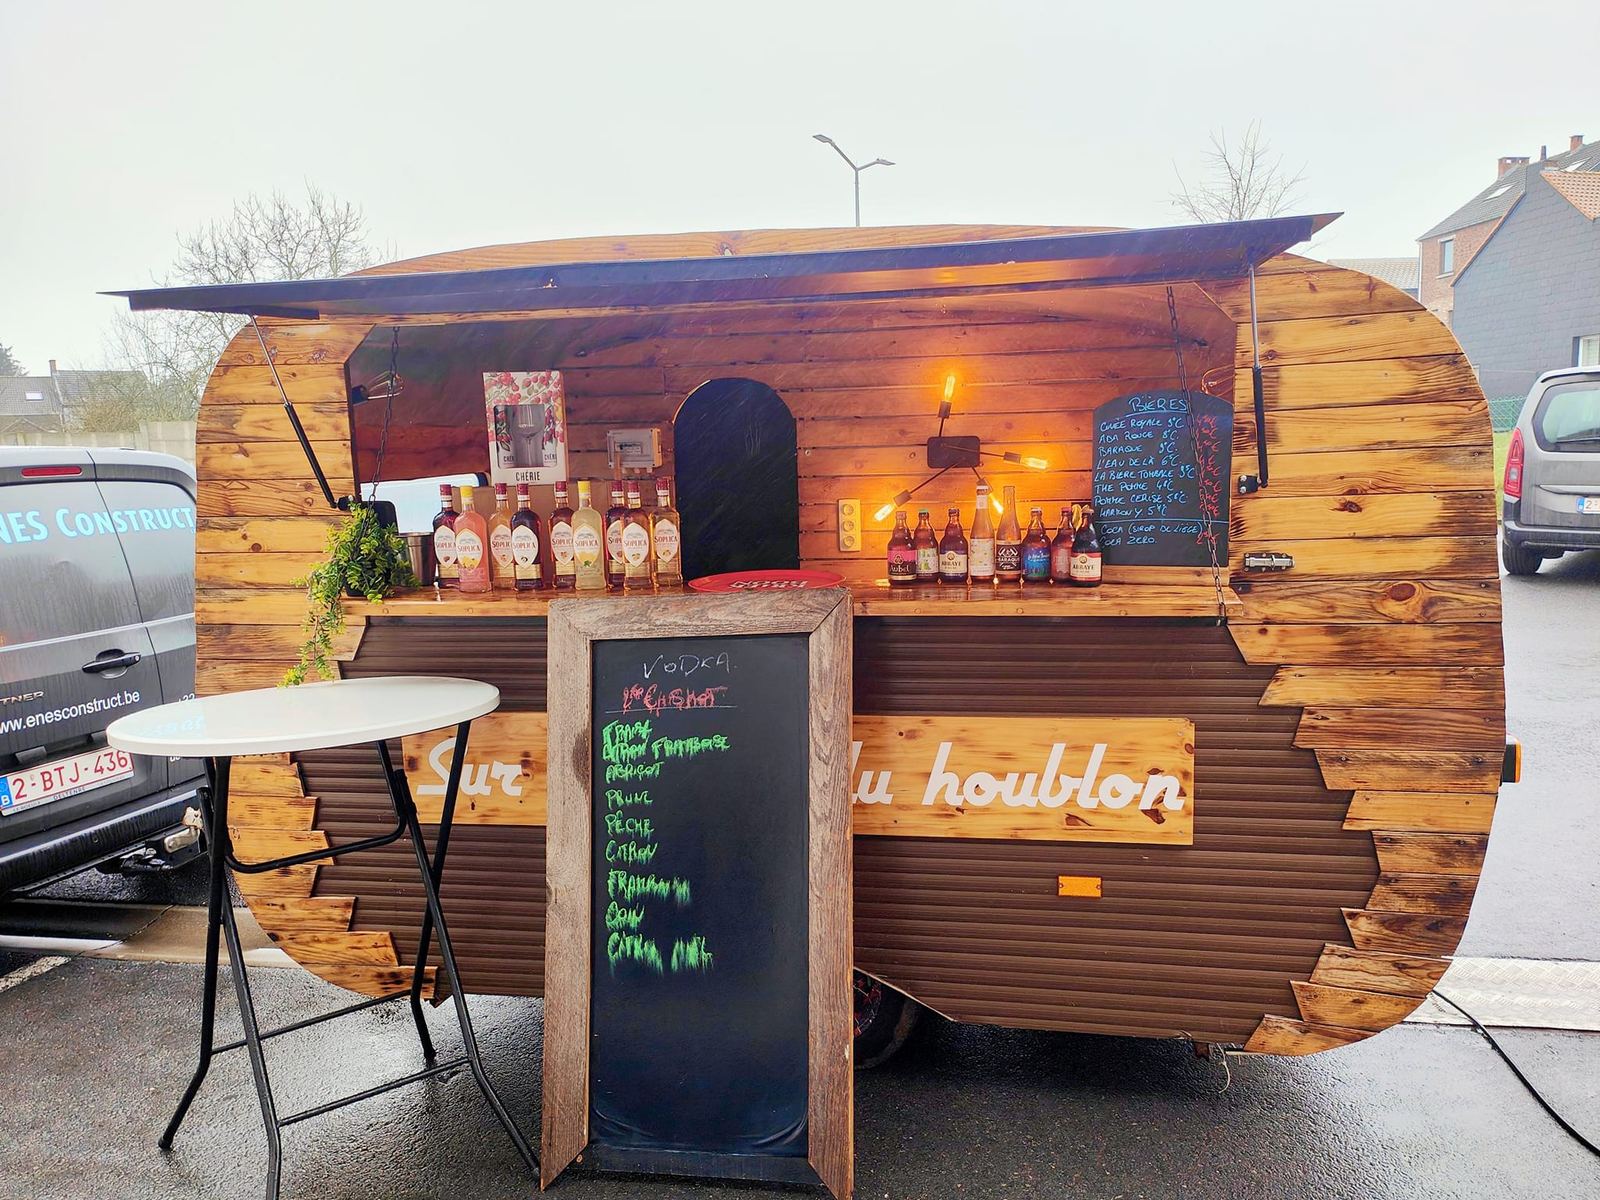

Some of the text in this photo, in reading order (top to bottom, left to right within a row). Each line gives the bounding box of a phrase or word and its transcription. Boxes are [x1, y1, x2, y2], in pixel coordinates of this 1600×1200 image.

[12, 750, 128, 801] 2-BTJ-436
[416, 737, 523, 797] Sur
[921, 741, 1186, 811] houblon
